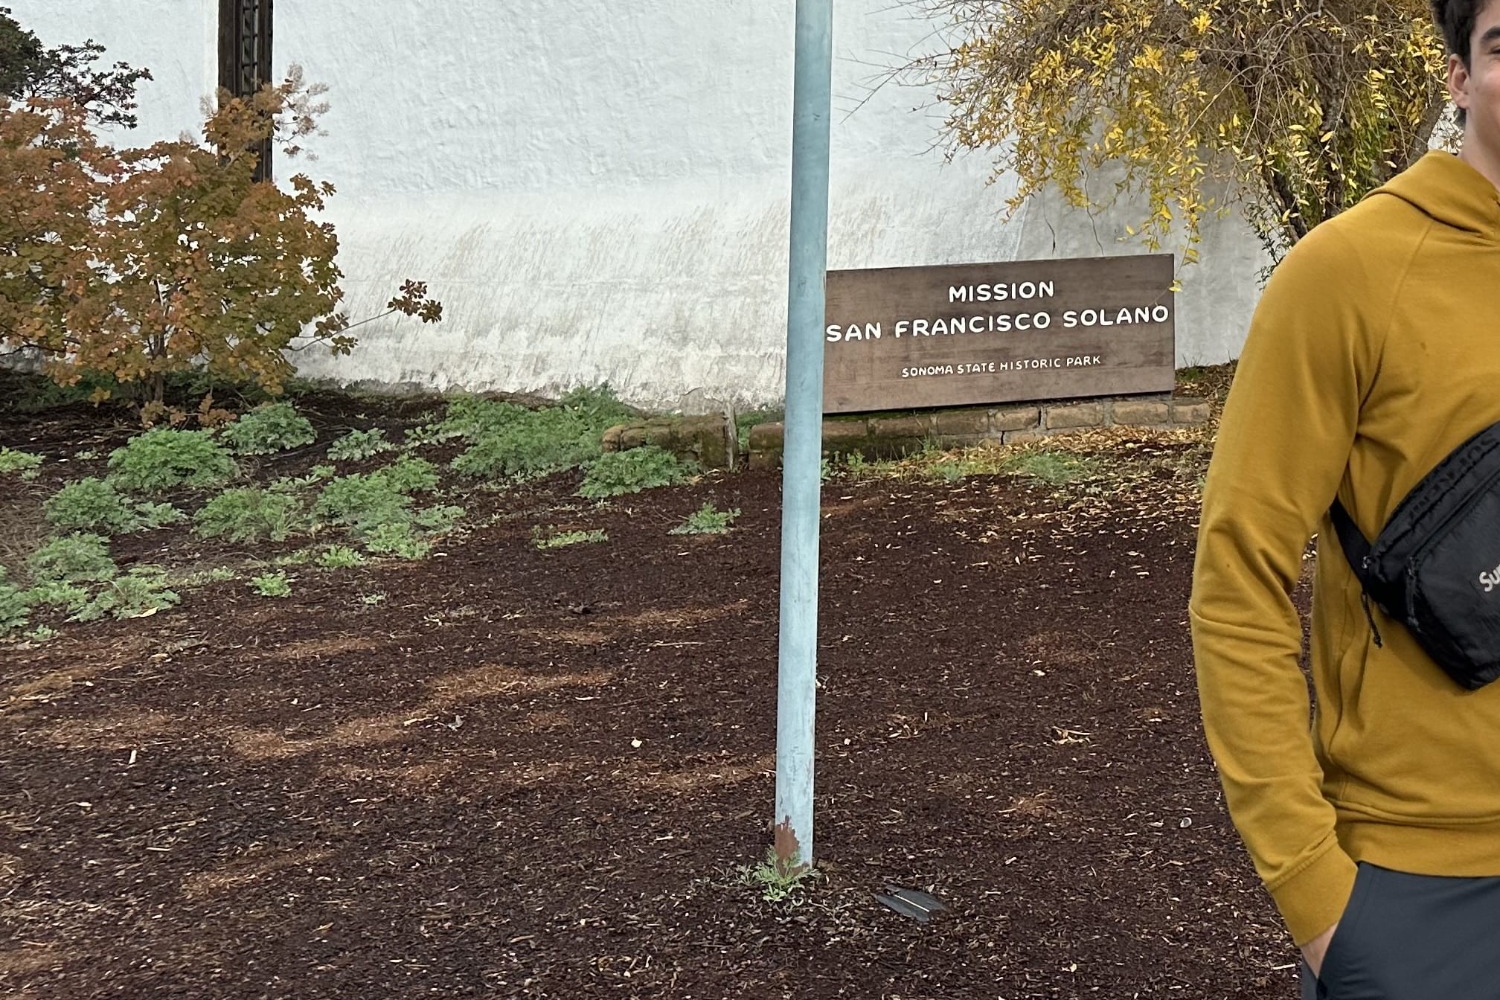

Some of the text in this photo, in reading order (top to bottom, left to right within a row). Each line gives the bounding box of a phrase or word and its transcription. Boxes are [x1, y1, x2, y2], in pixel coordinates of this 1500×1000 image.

[949, 281, 1054, 303] MISSION
[826, 305, 1169, 342] SAN FRANCISCO SOLANO
[901, 355, 1101, 378] SONOMA STATE HISTORIC PARK
